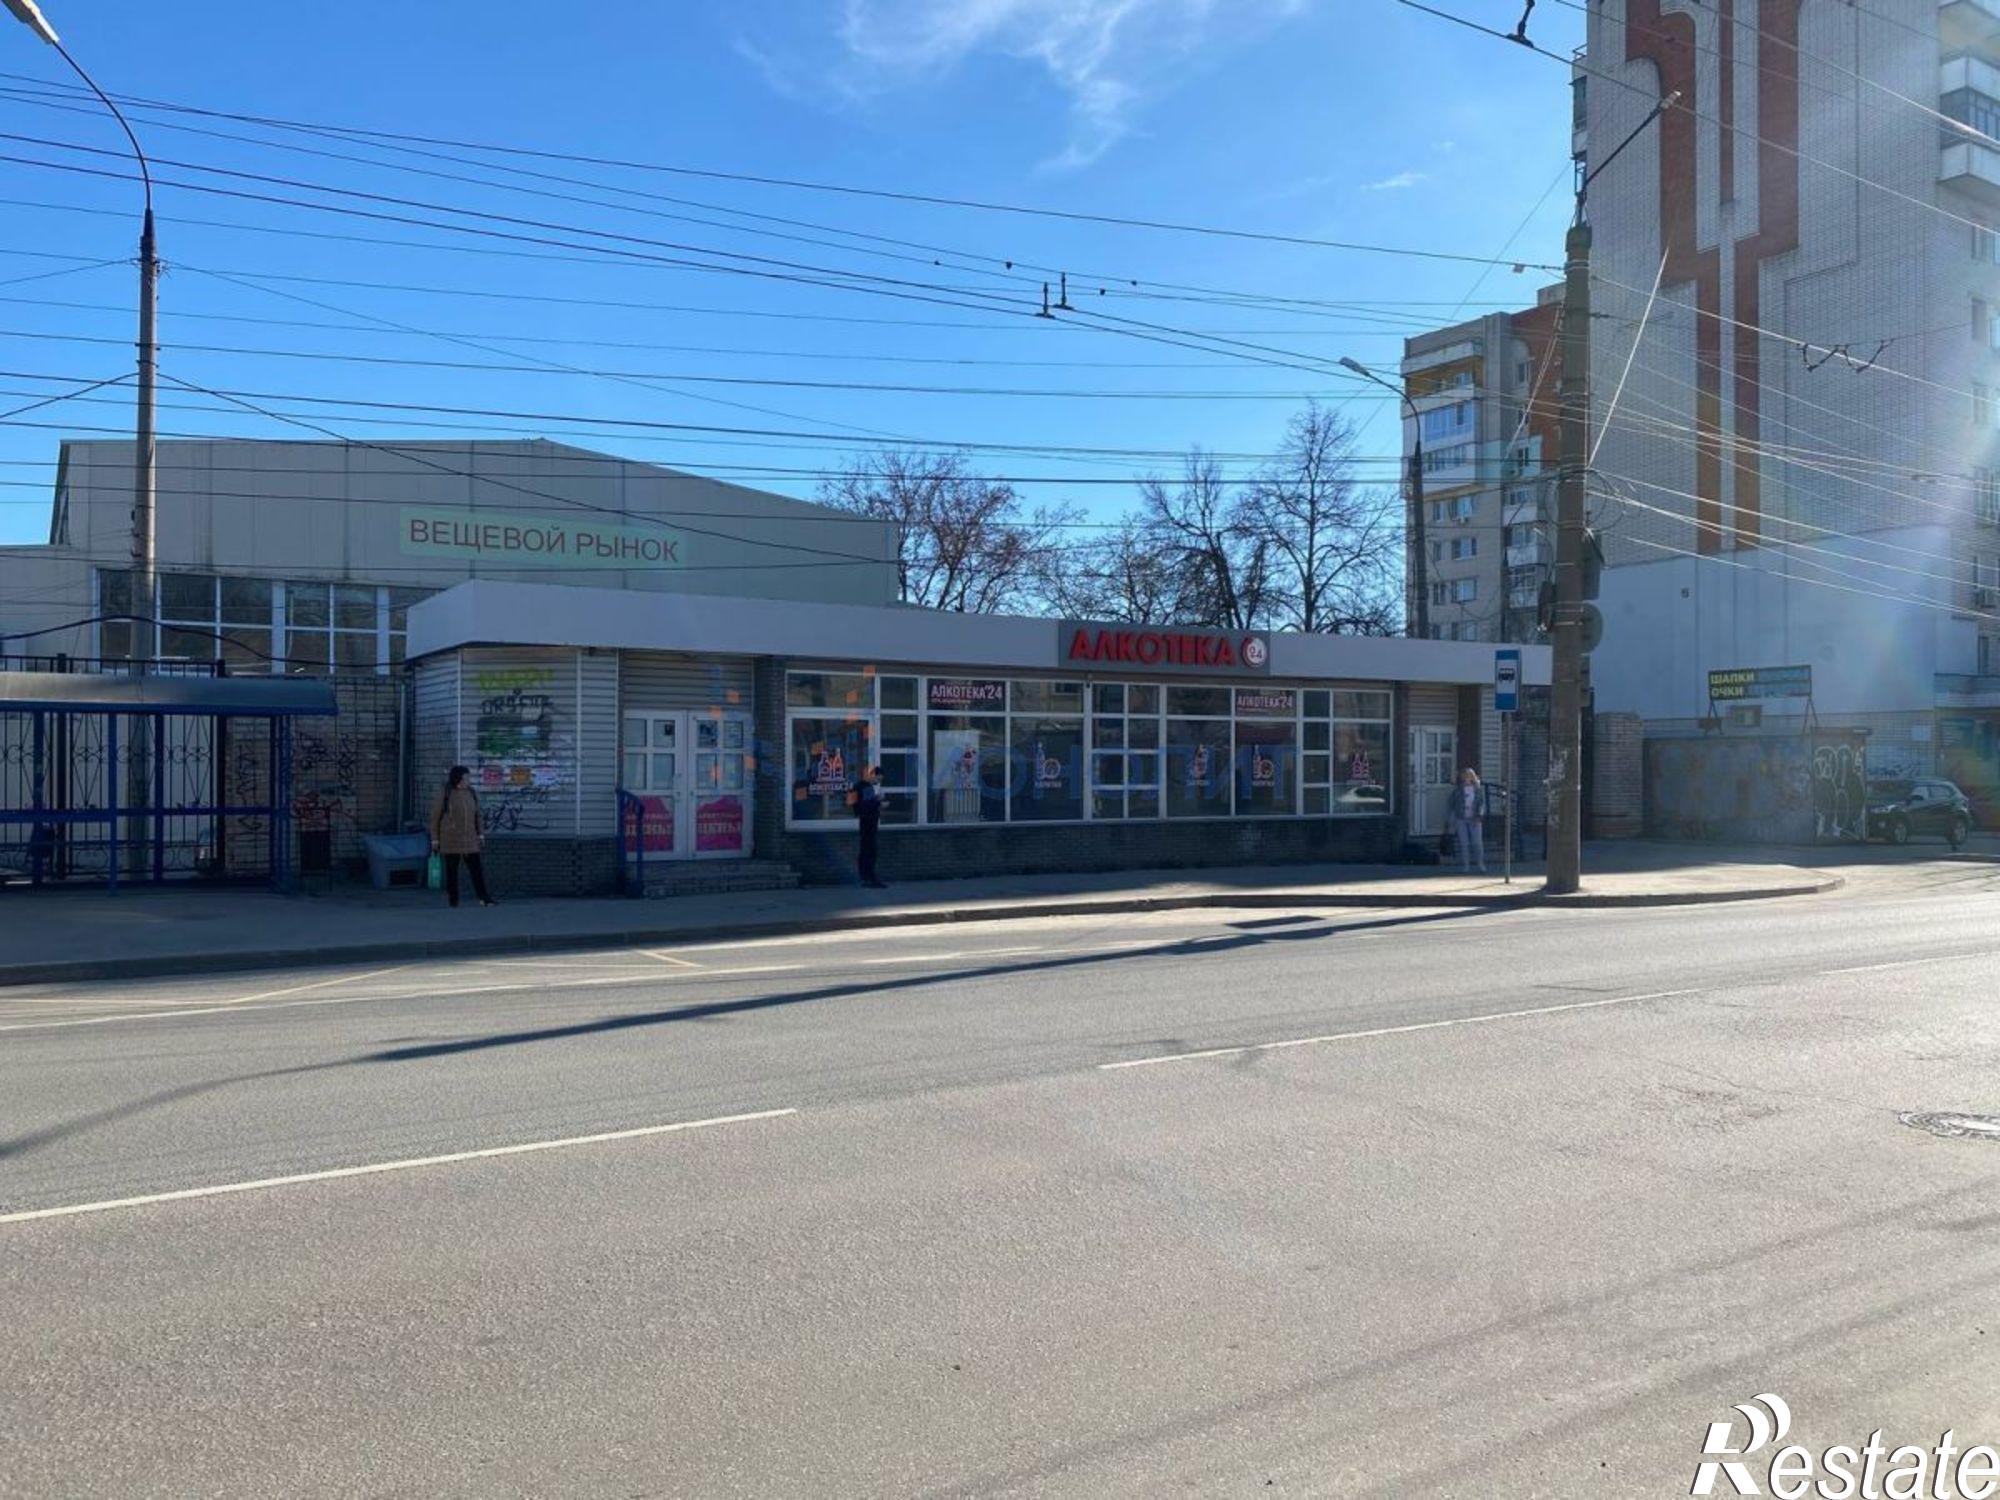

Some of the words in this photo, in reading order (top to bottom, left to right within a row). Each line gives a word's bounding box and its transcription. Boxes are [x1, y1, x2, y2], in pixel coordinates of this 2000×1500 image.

[410, 519, 565, 554] ВЕЩЕВОЙ
[576, 532, 679, 562] РЫНОК
[1069, 627, 1238, 667] АЛКОТЕКА
[1711, 672, 1755, 684] ШАПКИ
[1711, 686, 1743, 698] ОЧКИ
